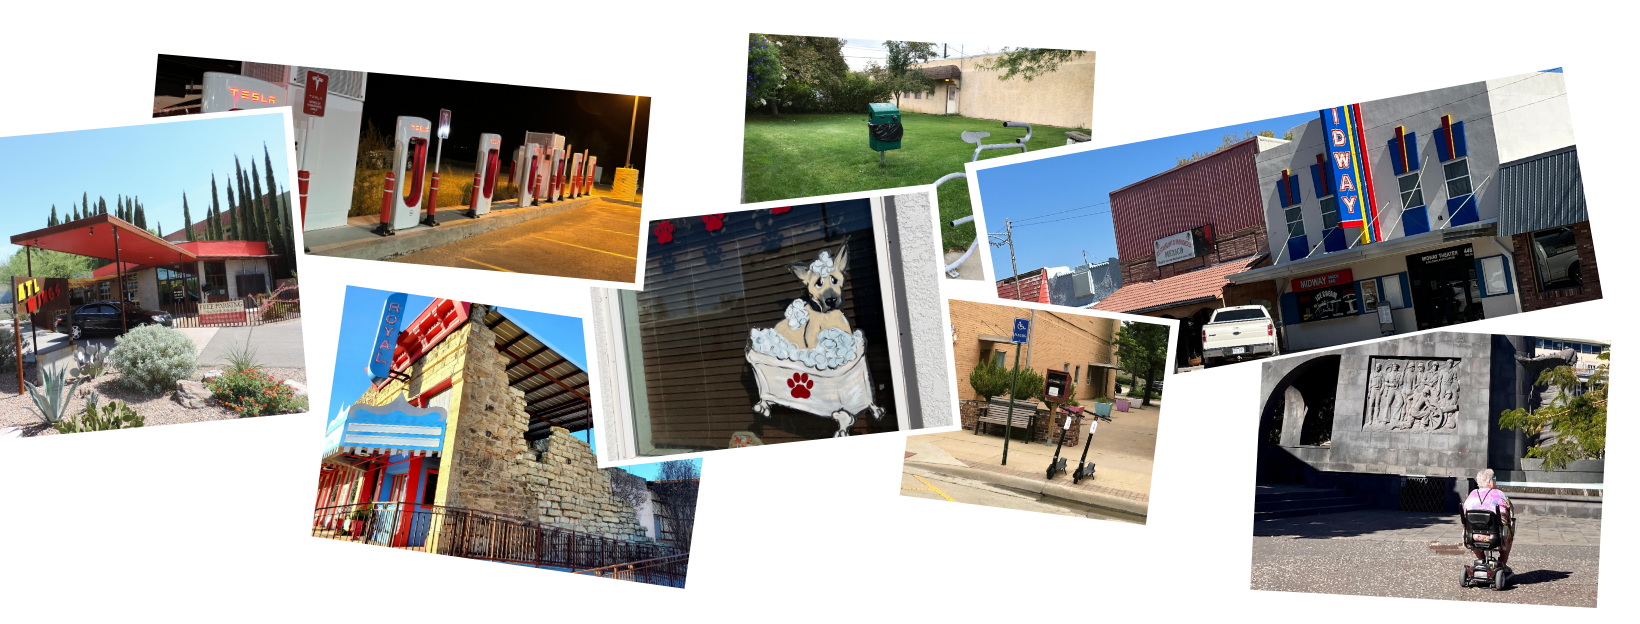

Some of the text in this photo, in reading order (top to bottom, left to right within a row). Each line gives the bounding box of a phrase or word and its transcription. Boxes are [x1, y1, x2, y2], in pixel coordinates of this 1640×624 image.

[229, 86, 276, 105] TESLA
[1164, 247, 1184, 258] MEXICO
[18, 278, 40, 302] ATL
[1300, 276, 1327, 289] MIDWAY
[27, 283, 61, 313] WINGS
[215, 301, 243, 309] PARKING
[375, 302, 402, 364] ROYAL
